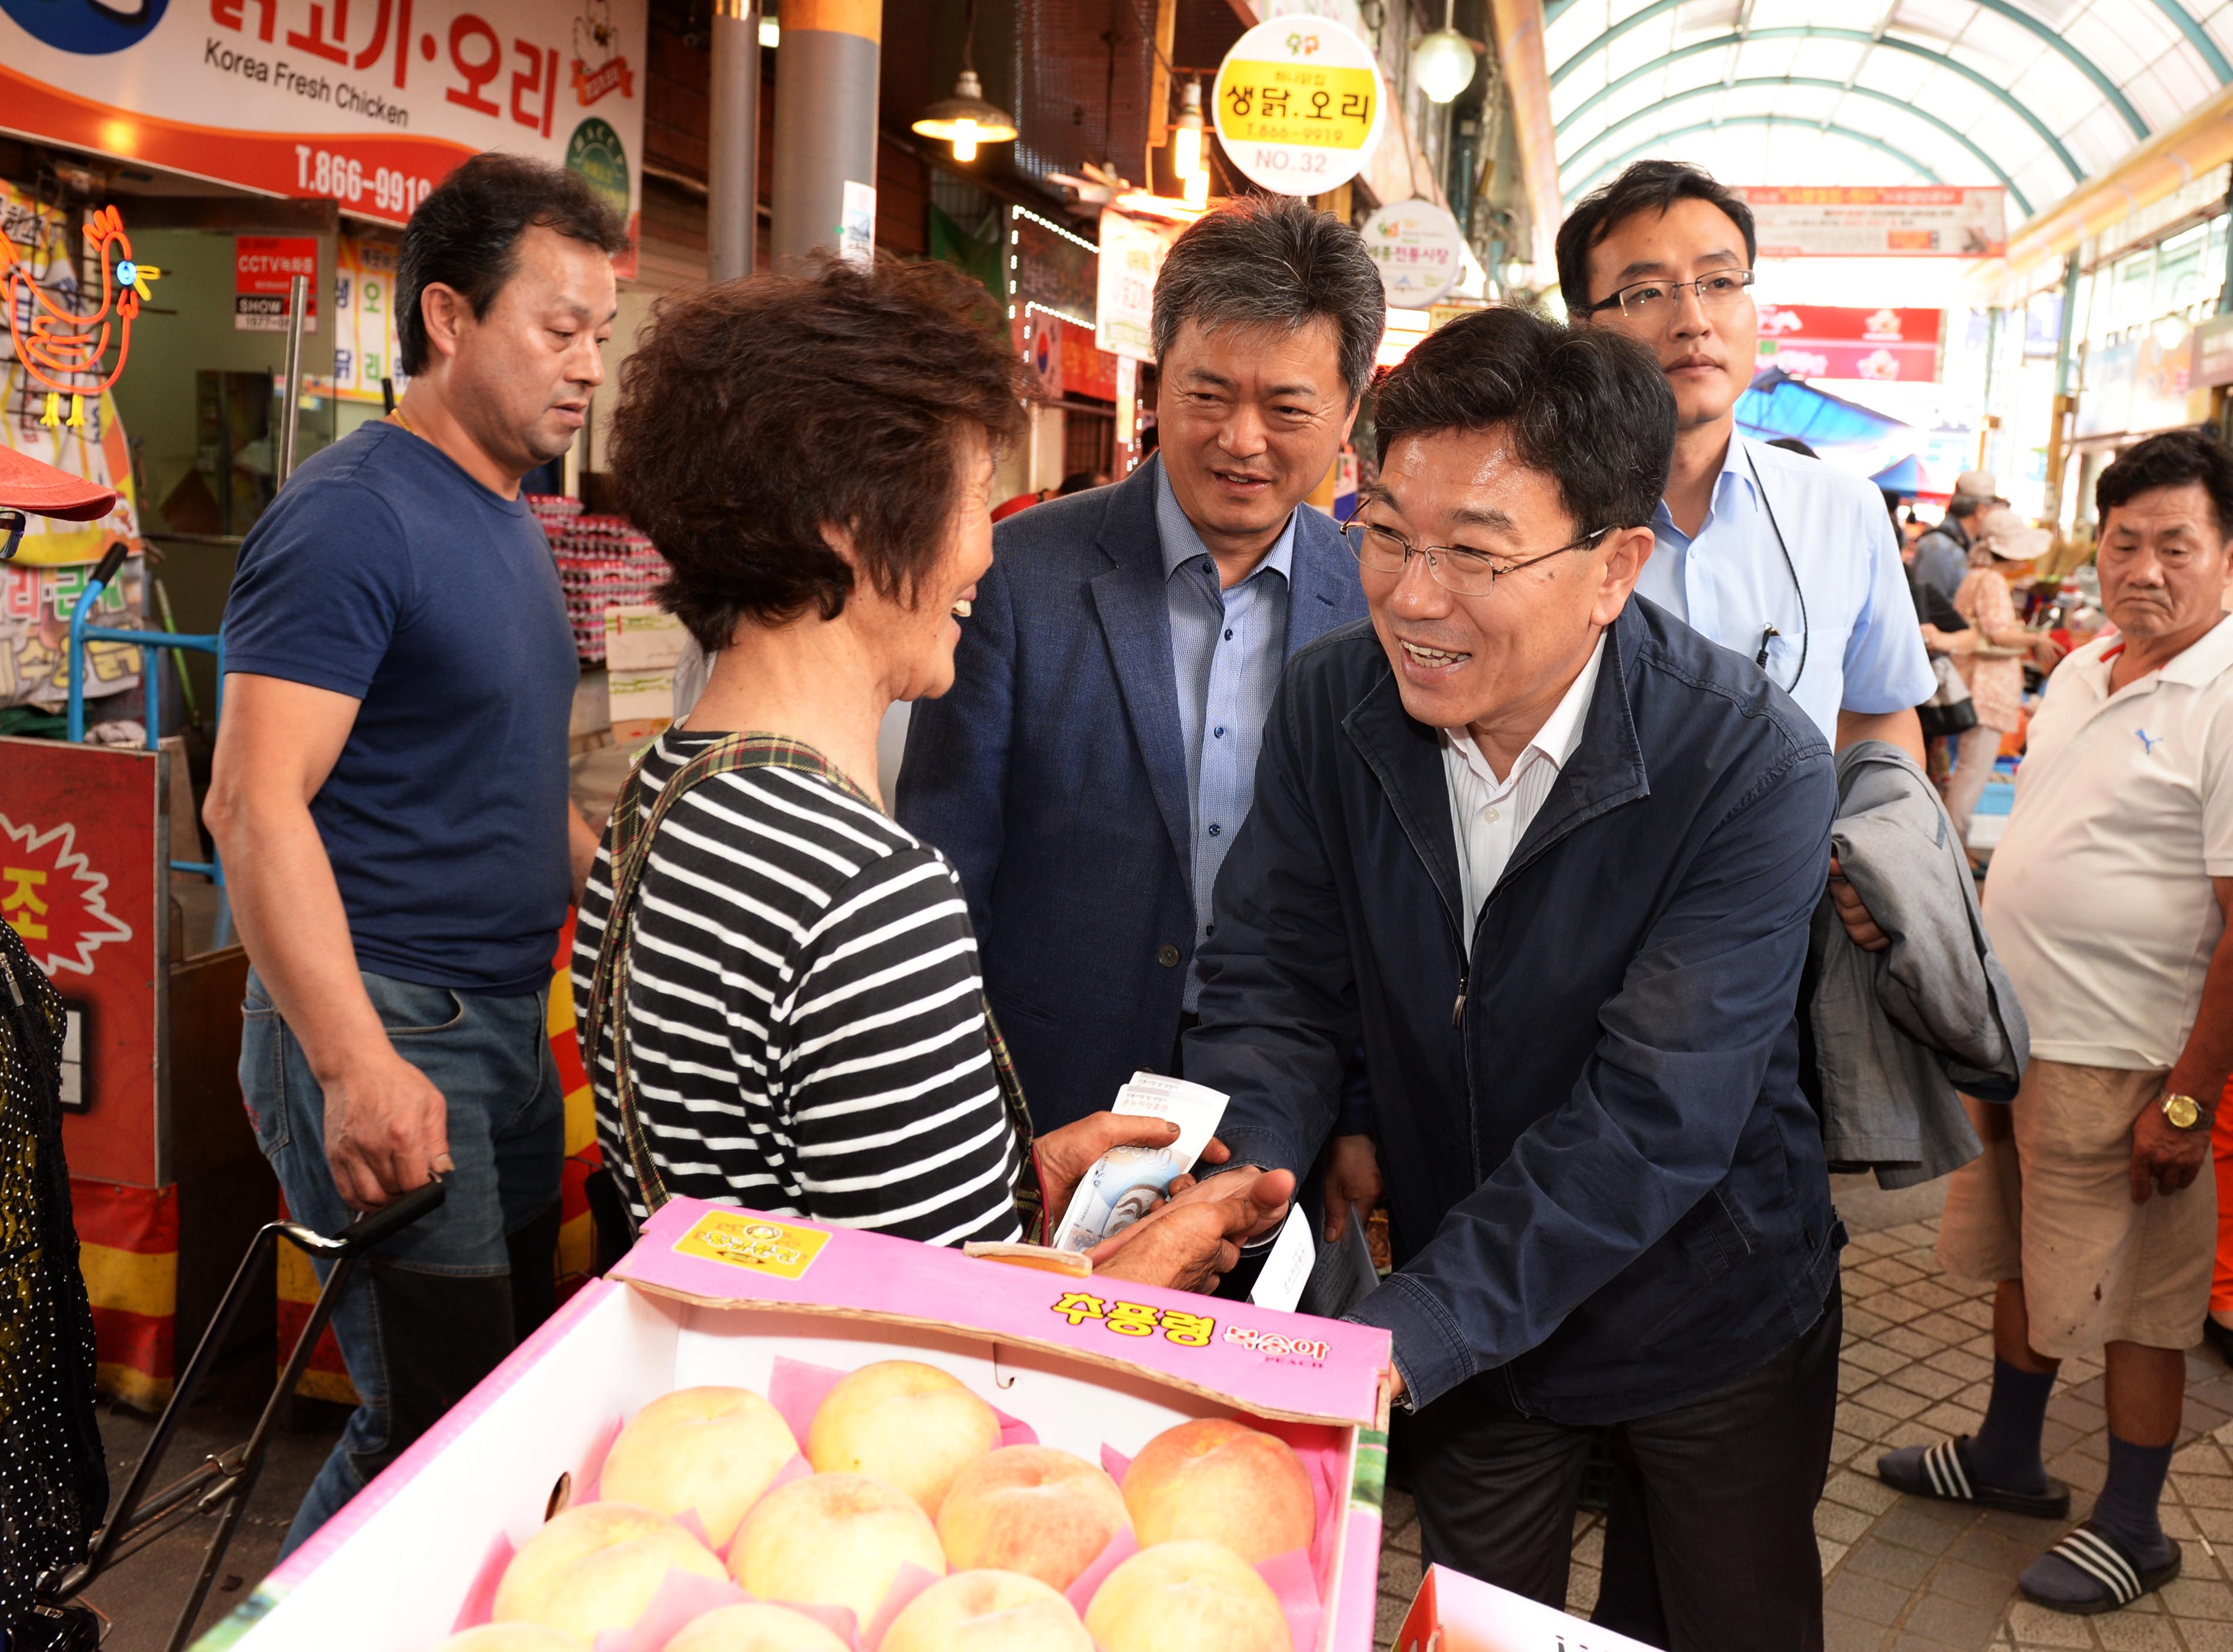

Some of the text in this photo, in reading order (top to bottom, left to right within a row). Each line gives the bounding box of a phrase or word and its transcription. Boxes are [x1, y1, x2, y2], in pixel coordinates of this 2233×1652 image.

[205, 36, 410, 128] Korea Fresh Chicken
[1226, 85, 1369, 125] 생닭.오리
[1246, 123, 1344, 142] T.866-9919
[1255, 149, 1327, 173] NO.32
[239, 298, 282, 314] SHOW
[1, 866, 49, 941] 조
